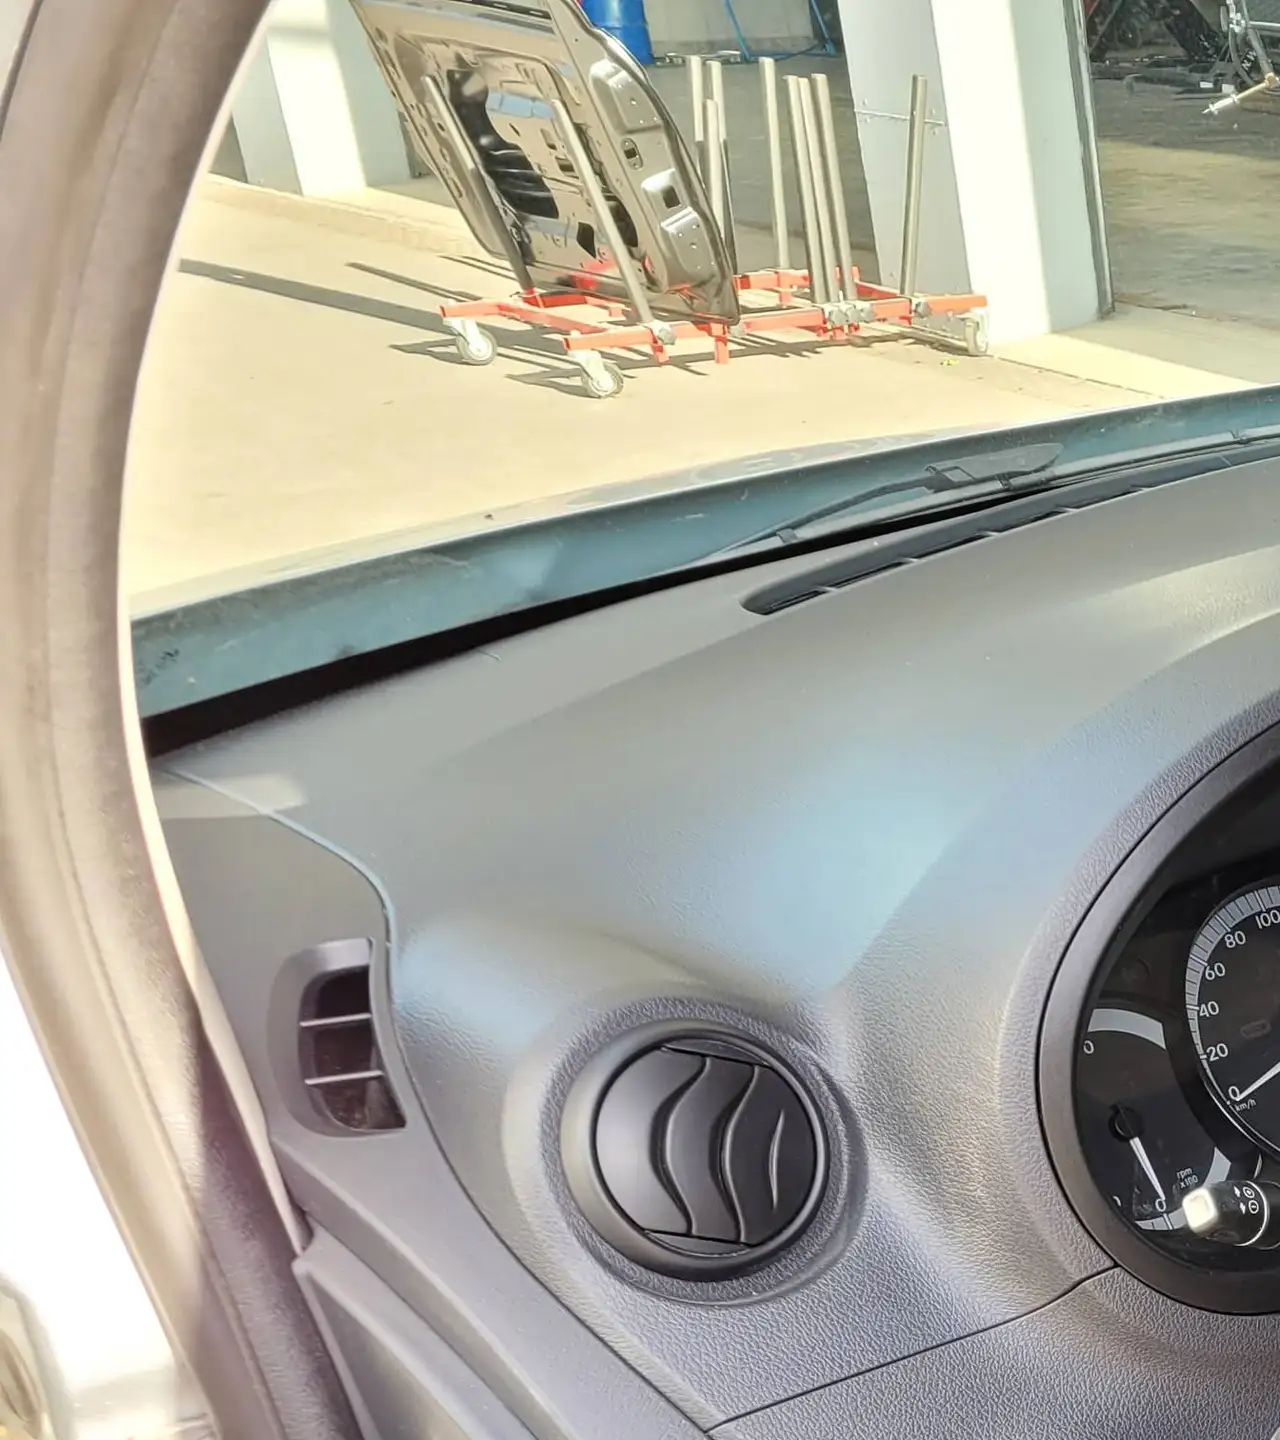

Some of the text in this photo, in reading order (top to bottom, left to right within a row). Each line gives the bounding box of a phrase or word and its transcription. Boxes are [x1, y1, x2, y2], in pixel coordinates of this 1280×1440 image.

[1224, 930, 1247, 949] 80
[1204, 962, 1226, 981] 60
[1199, 1000, 1220, 1019] 40
[1206, 1043, 1229, 1062] 20
[1227, 1085, 1241, 1101] 0
[1234, 1098, 1257, 1112] km/h
[1176, 1167, 1193, 1180] rpm
[1155, 1198, 1167, 1212] 0
